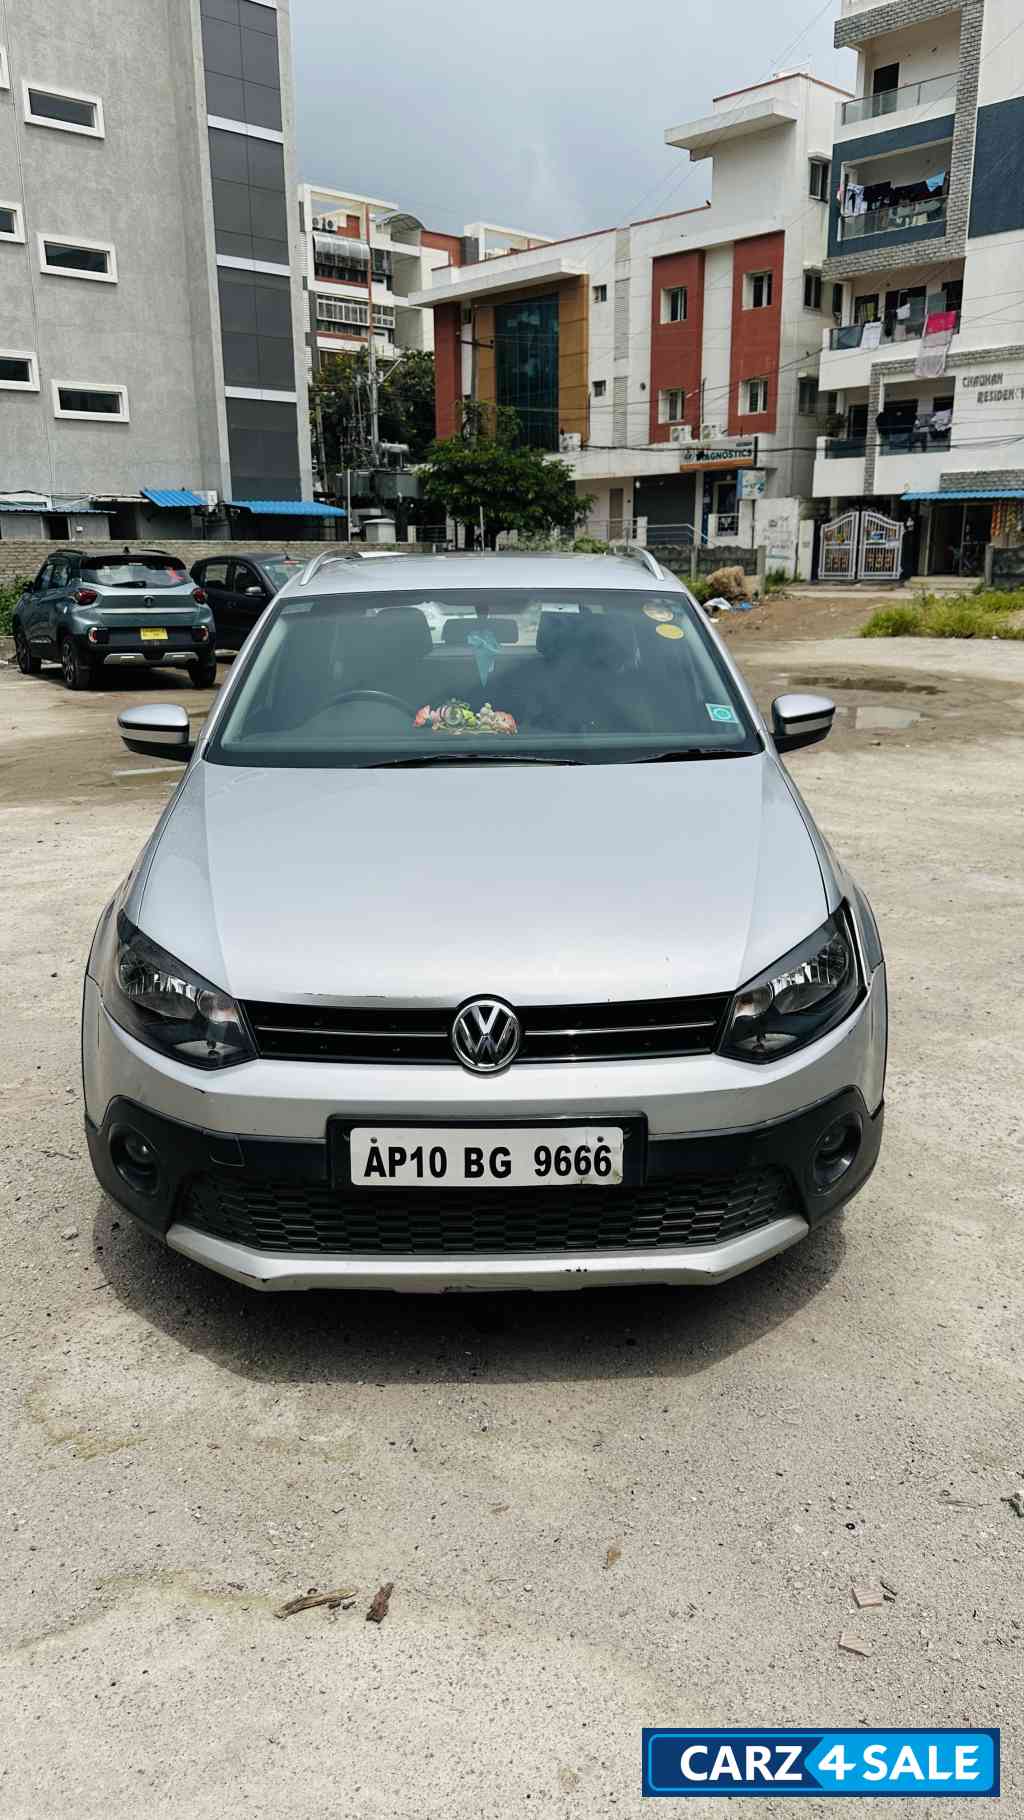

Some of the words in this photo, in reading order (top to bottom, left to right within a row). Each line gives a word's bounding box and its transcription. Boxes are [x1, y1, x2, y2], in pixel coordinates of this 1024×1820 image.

[363, 1146, 447, 1178] AP10
[464, 1147, 512, 1179] BG
[534, 1144, 612, 1177] 9666
